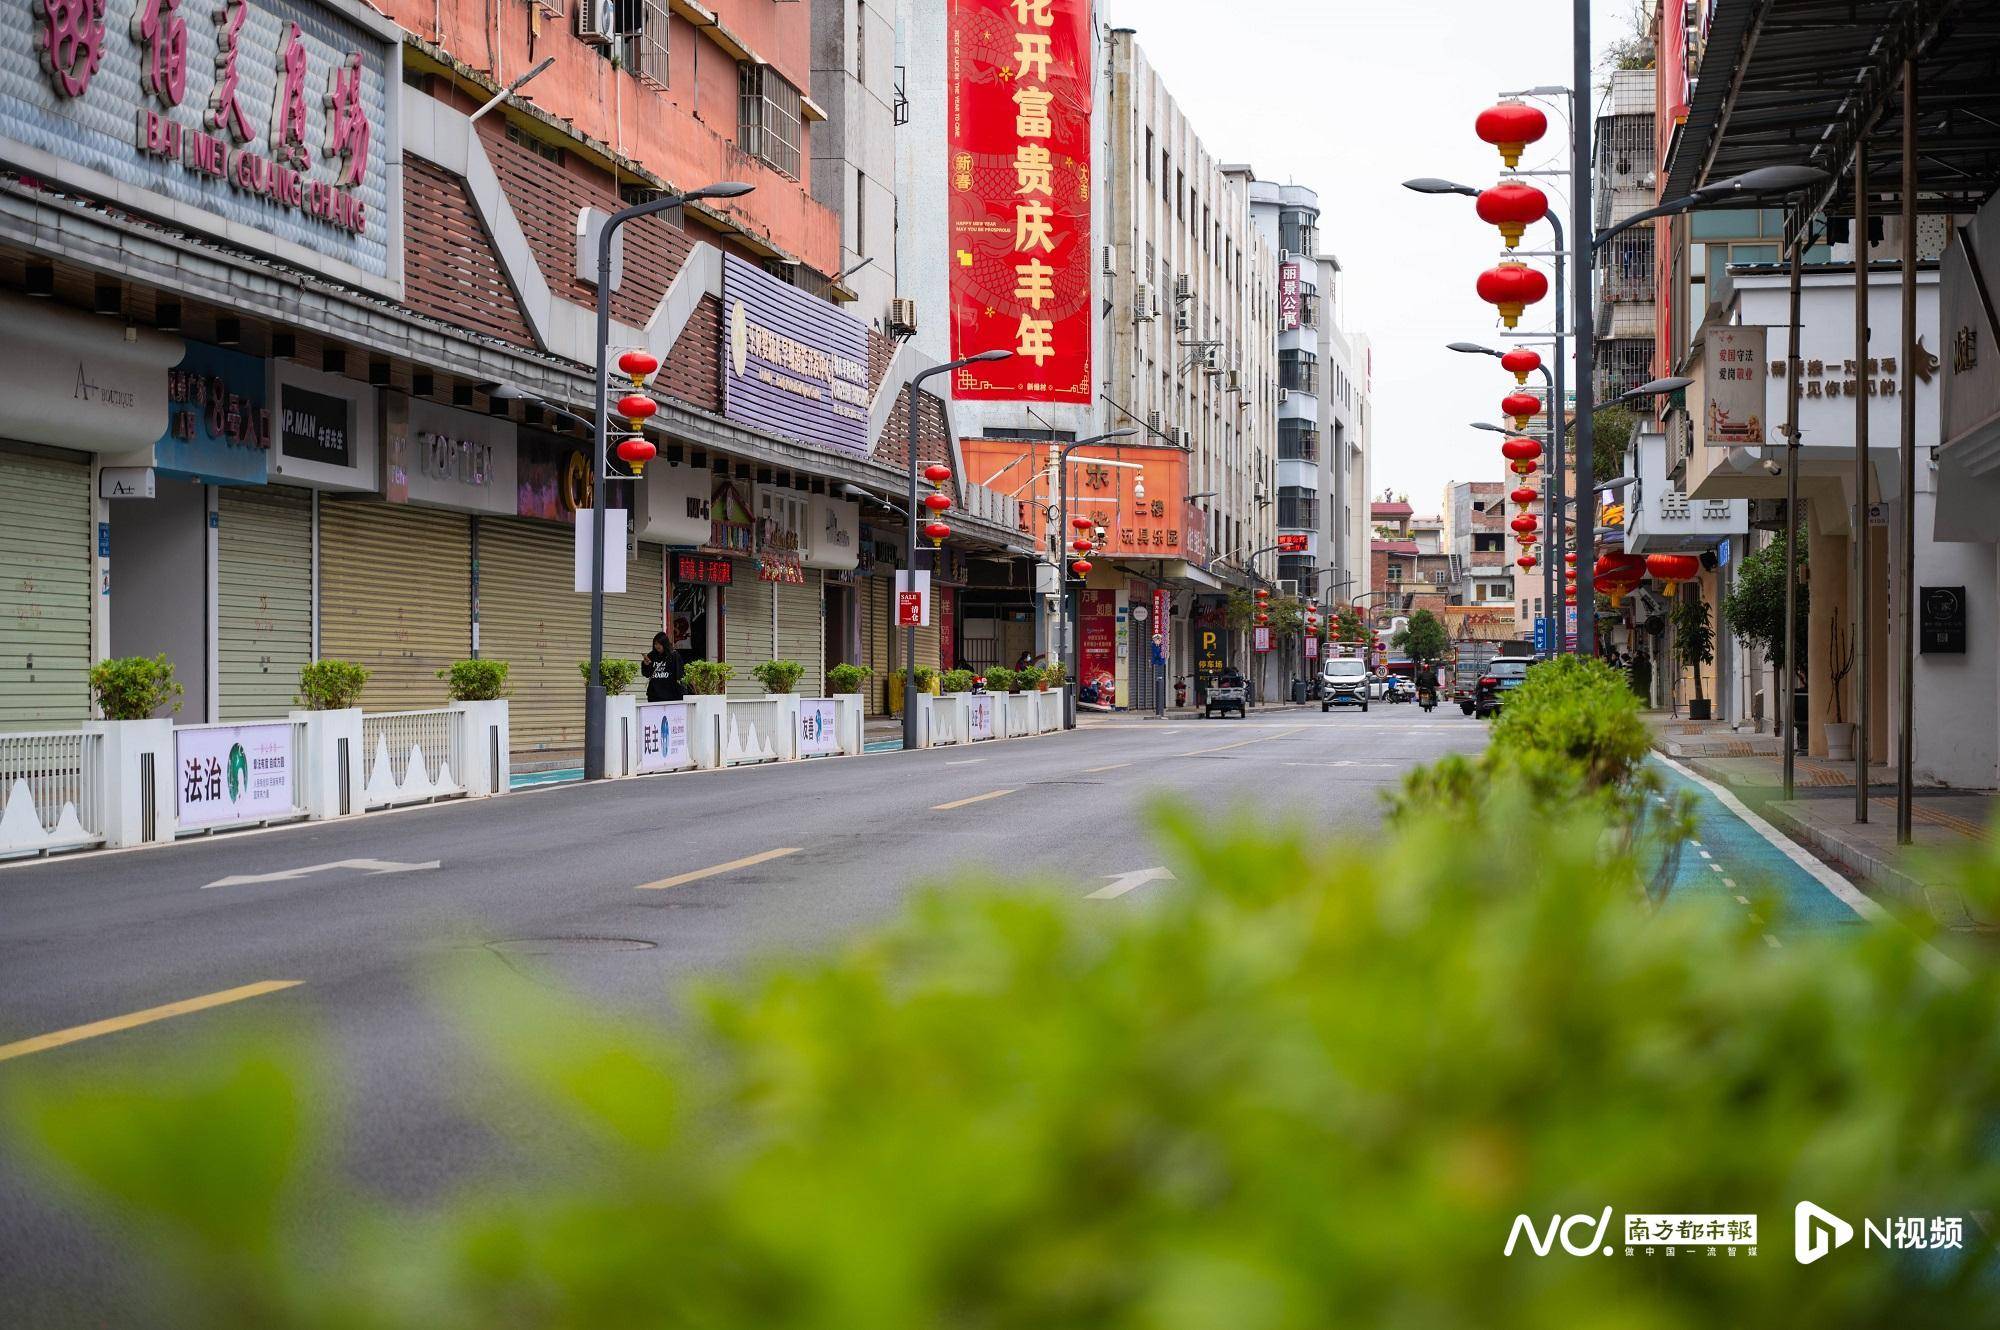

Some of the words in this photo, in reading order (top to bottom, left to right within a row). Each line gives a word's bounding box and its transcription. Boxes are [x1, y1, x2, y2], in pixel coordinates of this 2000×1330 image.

[146, 108, 182, 162] BAI
[193, 128, 228, 180] MEI
[236, 147, 301, 208] GUANG
[309, 180, 366, 234] CHANG
[955, 154, 972, 190] 新春
[1011, 0, 1055, 367] 花开富贵庆丰年
[1283, 265, 1297, 327] 丽景公寓
[1720, 349, 1753, 362] 爱国守法
[1720, 367, 1753, 380] 爱岗敬业
[101, 387, 135, 408] BOUTIQUE
[1135, 500, 1164, 518] 二楼
[1121, 528, 1179, 546] 玩具乐园
[1203, 631, 1216, 650] P
[1199, 660, 1223, 668] 停车场
[644, 724, 659, 755] 民主
[802, 716, 814, 741] 友善
[185, 757, 221, 803] 法治
